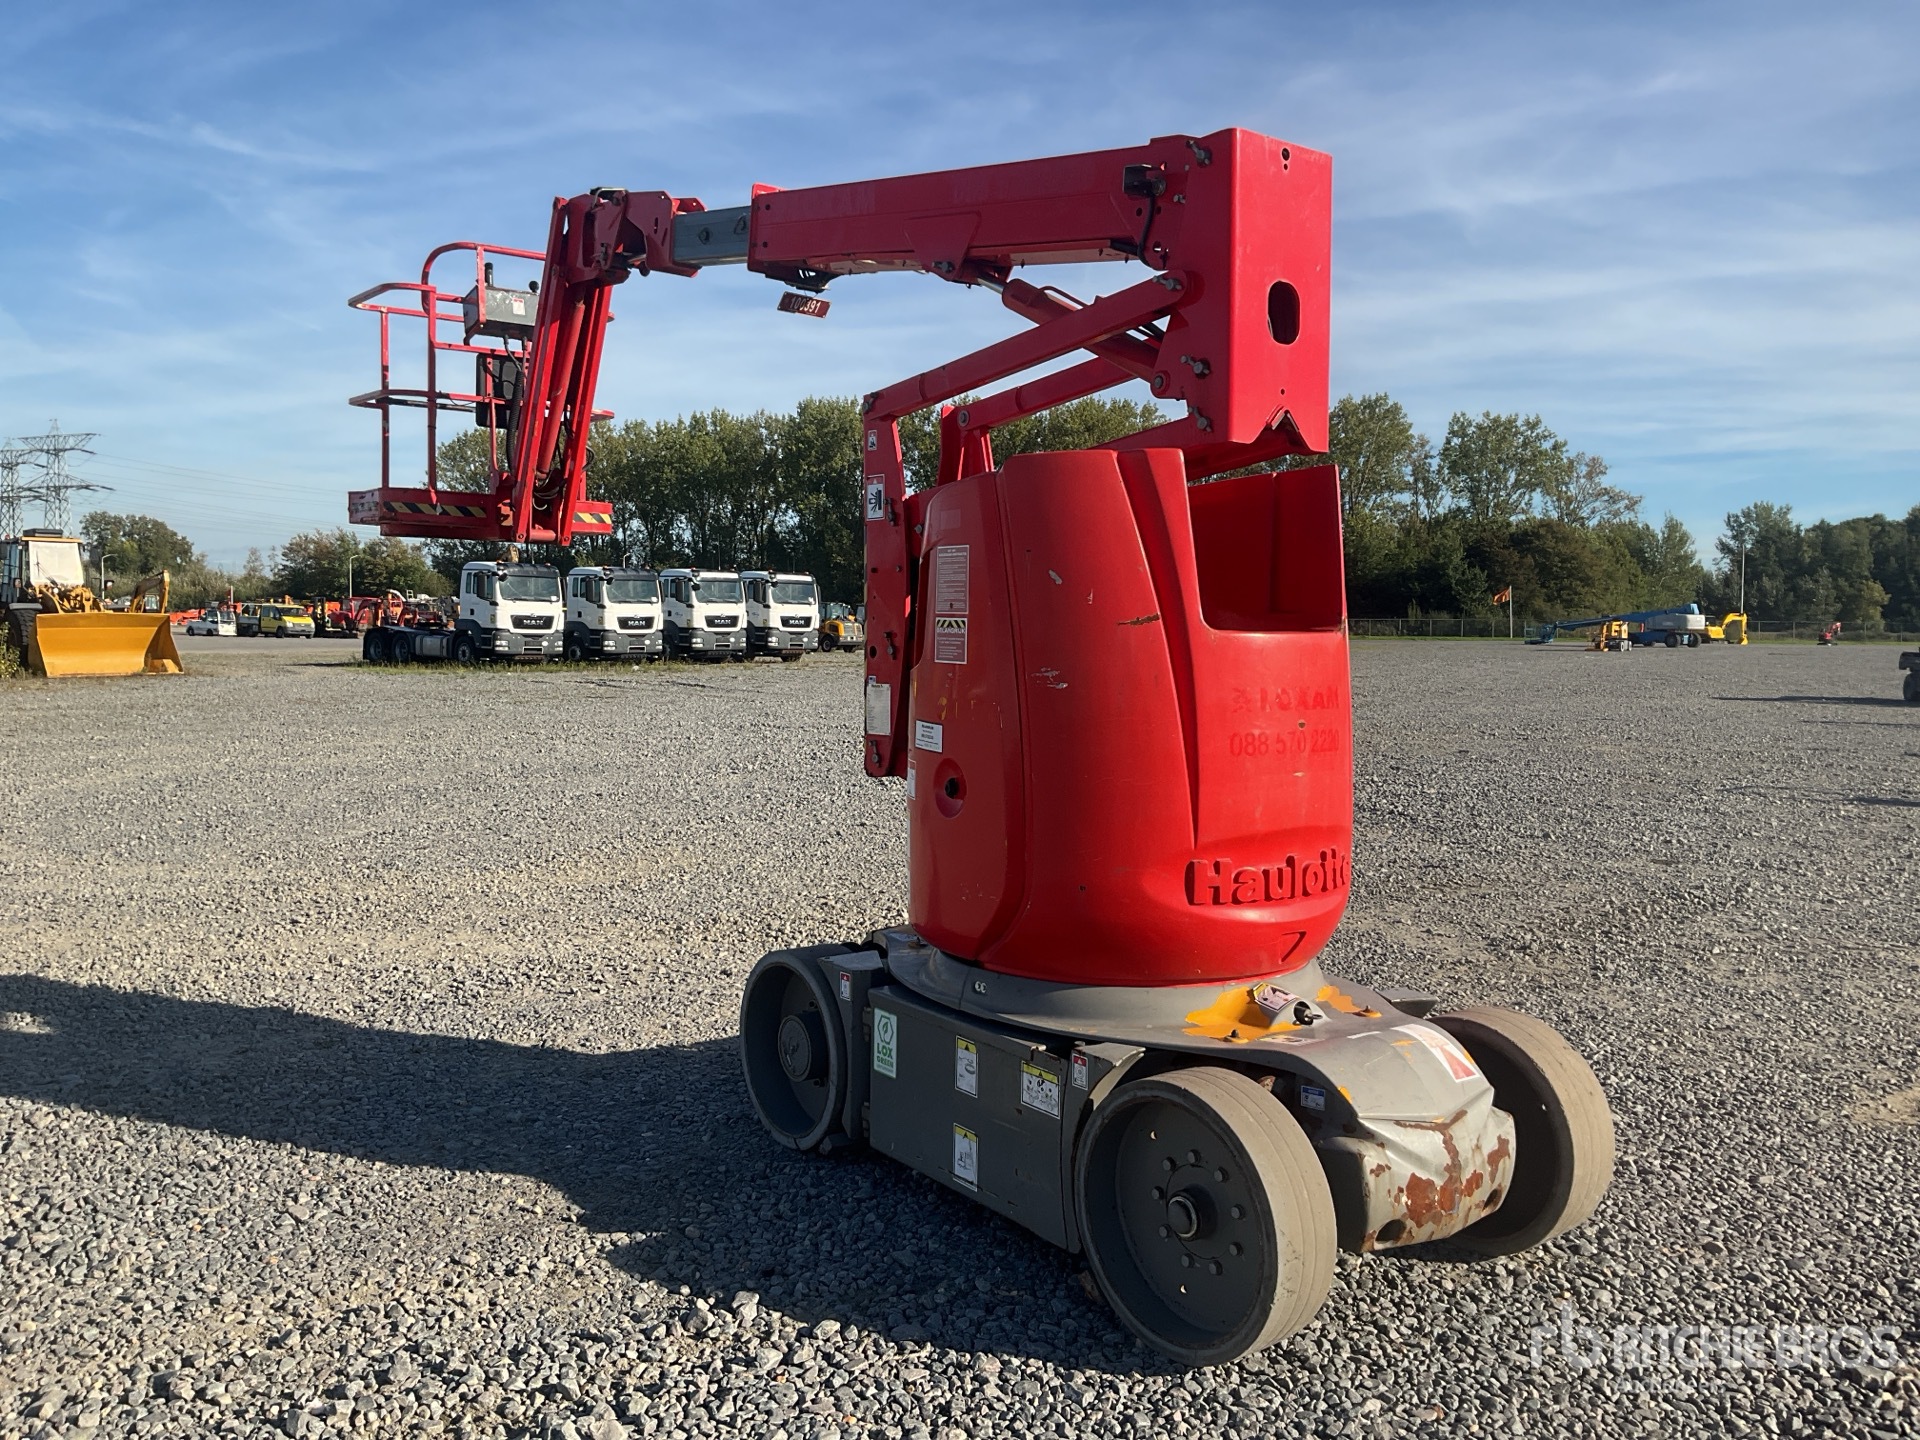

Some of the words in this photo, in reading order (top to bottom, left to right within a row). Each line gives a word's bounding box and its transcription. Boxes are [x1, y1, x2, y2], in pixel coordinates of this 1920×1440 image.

[789, 296, 822, 314] 100391
[1229, 732, 1269, 757] 088
[876, 1042, 893, 1060] LOX
[876, 1055, 894, 1069] GREEN
